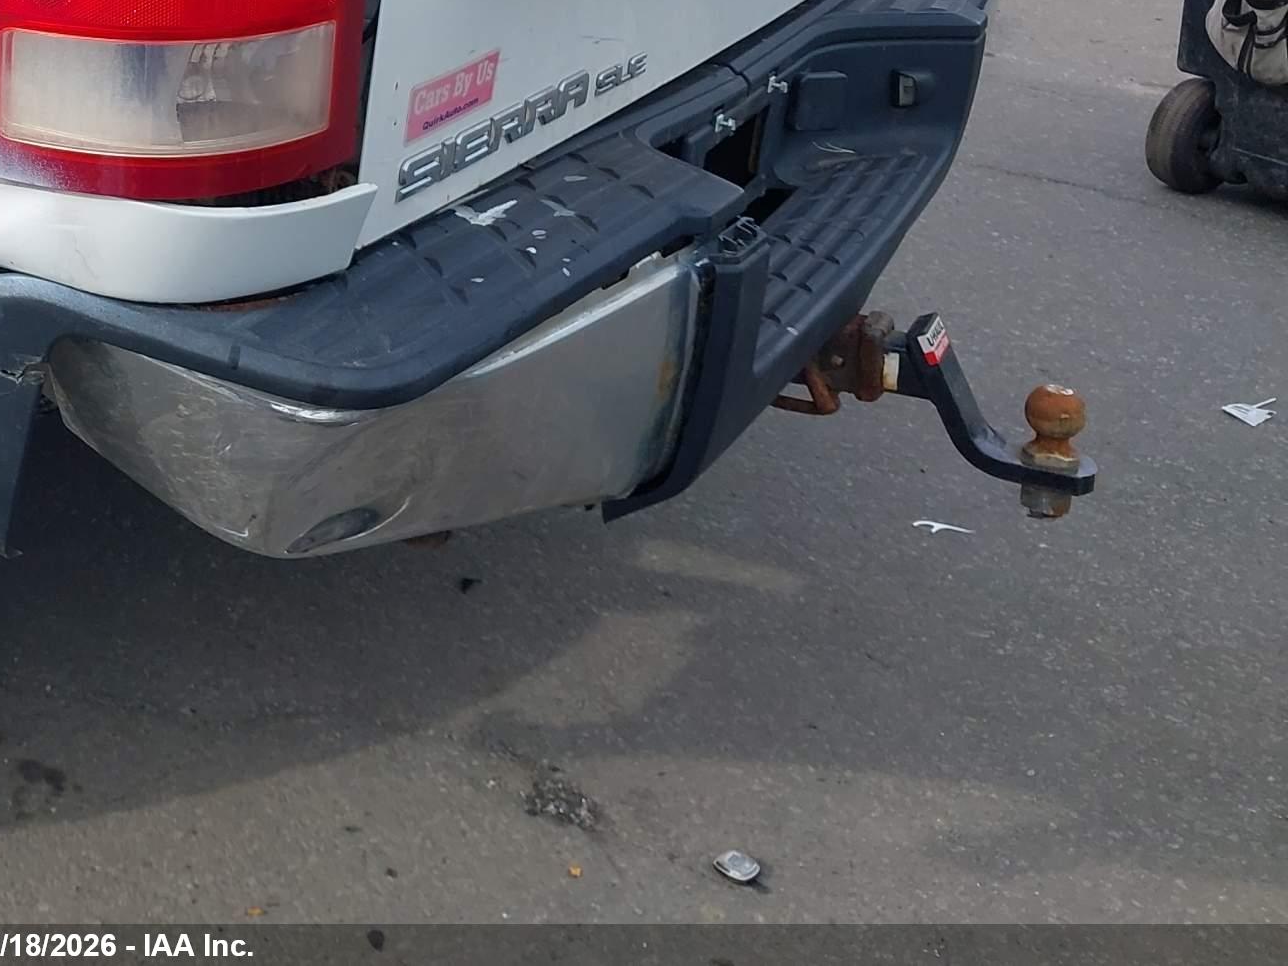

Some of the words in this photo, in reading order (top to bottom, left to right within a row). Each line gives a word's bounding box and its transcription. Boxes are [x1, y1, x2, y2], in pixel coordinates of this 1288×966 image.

[414, 89, 450, 115] Cars
[453, 72, 473, 97] By
[476, 60, 495, 85] Us
[423, 98, 479, 130] QuirkAuto.com
[397, 70, 590, 202] SIERRA
[595, 52, 648, 96] SLE
